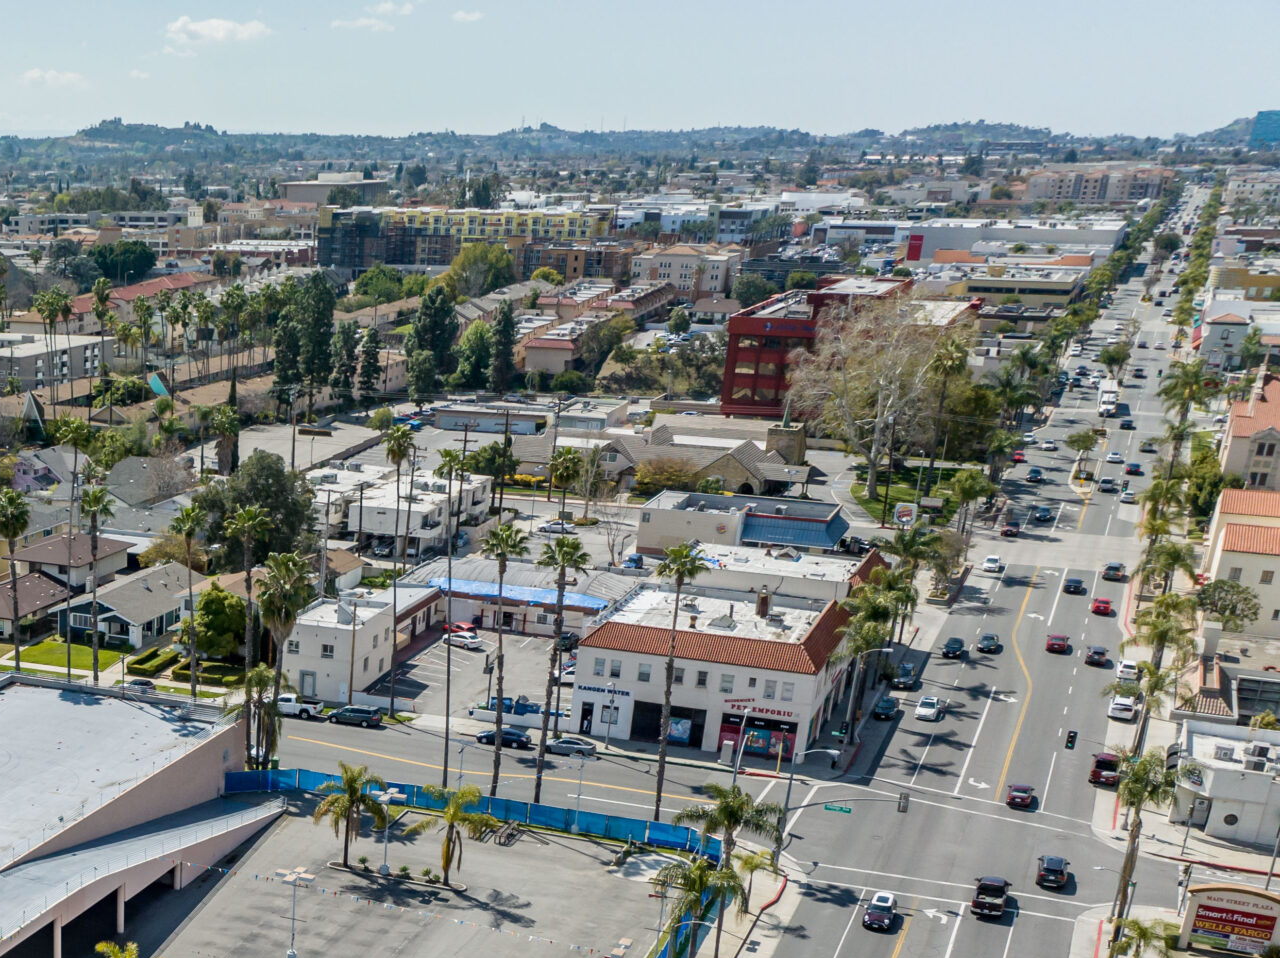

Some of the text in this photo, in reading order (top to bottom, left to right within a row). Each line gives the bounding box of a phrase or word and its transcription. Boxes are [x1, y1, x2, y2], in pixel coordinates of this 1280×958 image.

[578, 685, 630, 697] KANGEN WATER
[752, 707, 800, 718] EMPORIU
[1226, 899, 1251, 907] STREET
[1252, 902, 1274, 911] PLAZA
[1195, 920, 1232, 934] WELLS
[1233, 925, 1271, 939] FARGO
